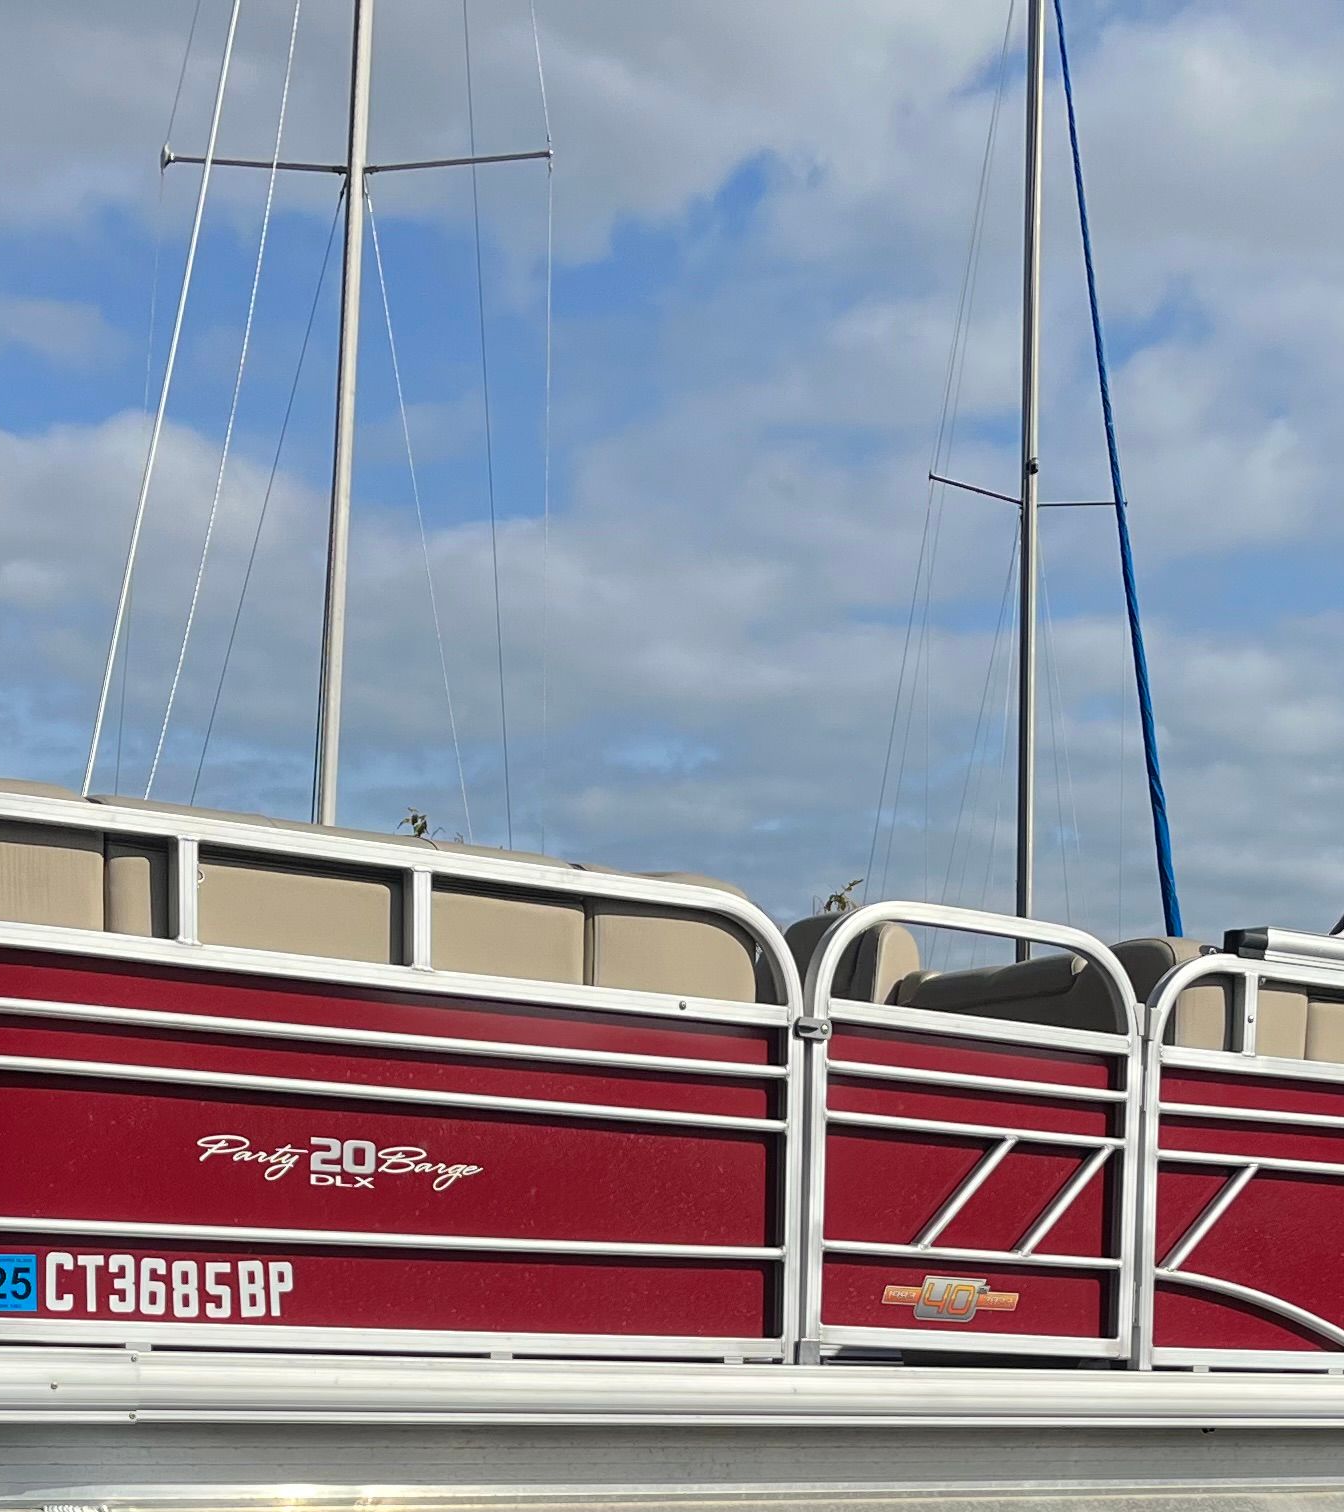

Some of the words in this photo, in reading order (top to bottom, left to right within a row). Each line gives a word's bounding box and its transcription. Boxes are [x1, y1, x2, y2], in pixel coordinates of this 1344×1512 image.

[196, 1134, 309, 1181] Party
[309, 1136, 377, 1174] 20
[377, 1146, 484, 1192] Barge
[309, 1174, 375, 1189] DLX
[45, 1251, 294, 1318] CT3685BP
[924, 1282, 976, 1316] 40
